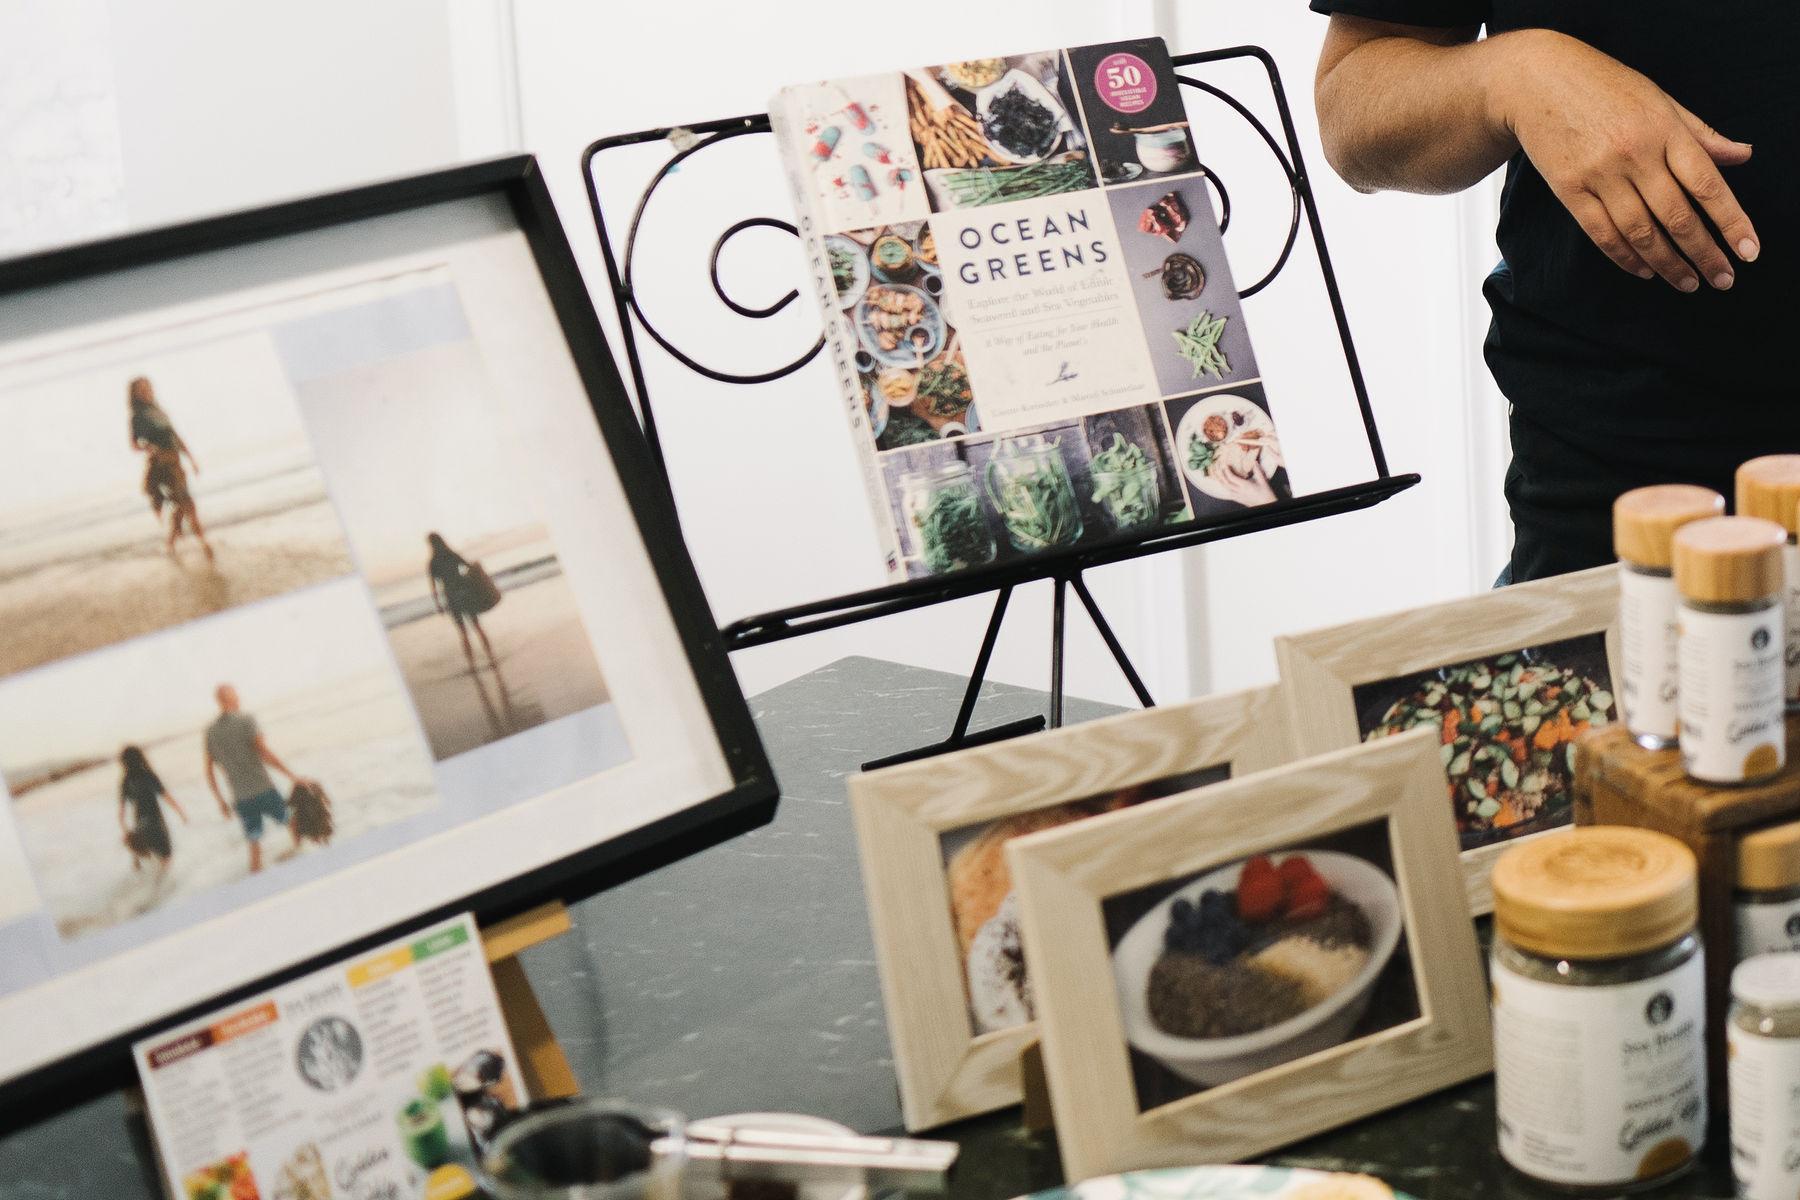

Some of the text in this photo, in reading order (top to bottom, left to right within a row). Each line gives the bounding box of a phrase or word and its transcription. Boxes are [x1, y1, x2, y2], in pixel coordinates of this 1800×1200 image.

[1106, 65, 1142, 89] 50
[960, 209, 1089, 249] OCEAN
[959, 241, 1107, 284] GREENS
